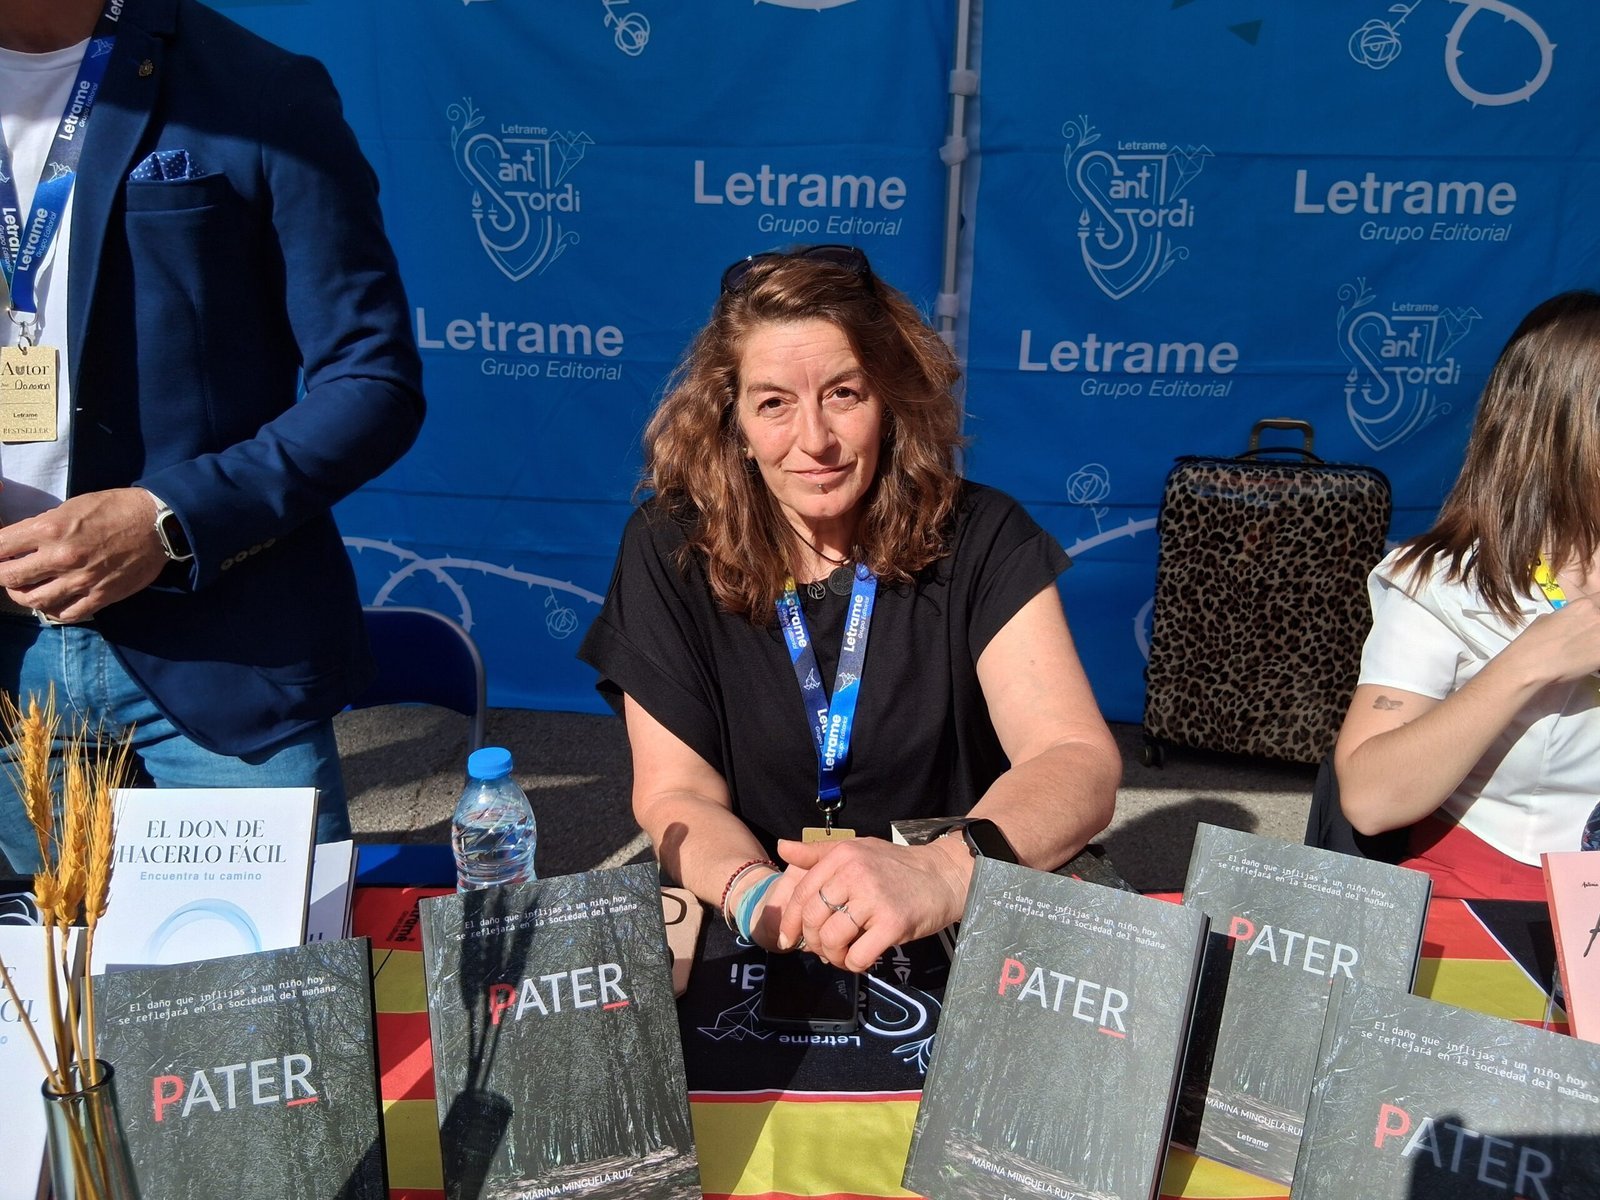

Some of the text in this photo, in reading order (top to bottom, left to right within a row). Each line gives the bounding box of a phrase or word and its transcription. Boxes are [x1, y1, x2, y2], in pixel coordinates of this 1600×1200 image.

[58, 80, 90, 140] Letrame
[501, 124, 548, 135] Letrame
[1118, 141, 1167, 151] Letrame
[694, 160, 907, 210] Letrame
[1293, 169, 1517, 216] Letrame
[2, 207, 20, 263] Letra
[17, 208, 48, 271] Letrame
[757, 213, 903, 237] Grupo Editorial
[1359, 221, 1512, 244] Grupo Editorial
[1392, 302, 1439, 312] Letrame
[416, 307, 624, 357] Letrame
[1018, 329, 1239, 374] Letrame
[1, 361, 50, 376] Autor
[481, 358, 622, 380] Grupo Editorial
[1080, 378, 1233, 399] Grupo Editorial
[843, 594, 863, 652] Letrame
[822, 714, 842, 772] Letrame
[147, 820, 265, 838] EL DON DE
[118, 839, 287, 863] HACERLO FÁCIL
[140, 871, 262, 881] Encuentra tu camino
[1241, 857, 1260, 868] daño
[1263, 864, 1277, 873] que
[1346, 882, 1366, 894] niño
[1371, 888, 1387, 899] hoy
[1289, 878, 1299, 886] la
[1345, 892, 1359, 901] del
[1364, 895, 1395, 910] mañana
[456, 933, 466, 941] se
[534, 918, 544, 926] la
[591, 908, 605, 917] del
[609, 903, 637, 913] mañana
[465, 921, 474, 929] El
[480, 917, 500, 927] daño
[504, 914, 520, 923] que
[590, 897, 609, 907] niño
[613, 895, 627, 904] hoy
[1003, 891, 1012, 899] El
[1015, 894, 1033, 905] daño
[1036, 901, 1050, 910] que
[1103, 918, 1114, 926] un
[1118, 921, 1138, 932] niño
[1142, 926, 1158, 938] hoy
[1062, 916, 1071, 925] la
[1116, 930, 1131, 941] del
[1134, 934, 1166, 950] mañana
[1227, 916, 1359, 979] PATER
[0, 999, 38, 1022] CIL
[118, 1017, 130, 1026] se
[212, 1002, 223, 1011] la
[279, 991, 297, 1000] del
[302, 986, 337, 997] mañana
[130, 1003, 141, 1012] El
[147, 999, 171, 1010] daño
[176, 996, 194, 1007] que
[262, 984, 274, 992] un
[279, 979, 302, 989] niño
[307, 976, 325, 986] hoy
[488, 963, 628, 1025] PATER
[997, 957, 1129, 1033] PATER
[779, 1035, 860, 1046] Letrame
[1374, 1022, 1386, 1031] El
[1392, 1026, 1416, 1040] daño
[1421, 1035, 1440, 1048] que
[1447, 1042, 1495, 1062] inflijas
[1514, 1061, 1528, 1071] un
[1533, 1065, 1561, 1080] niño
[1566, 1074, 1588, 1088] hoy
[1360, 1031, 1600, 1104] se reflejará en la sociedad del mañana
[151, 1053, 317, 1123] PATER
[1206, 1097, 1303, 1137] MARINA MINGUELA RUI
[1236, 1131, 1269, 1148] Letrame
[1374, 1103, 1553, 1200] PATER
[522, 1168, 633, 1200] MARINA MINGUELA RUIZ
[972, 1157, 1076, 1200] MARINA MINGUELA RUIZ
